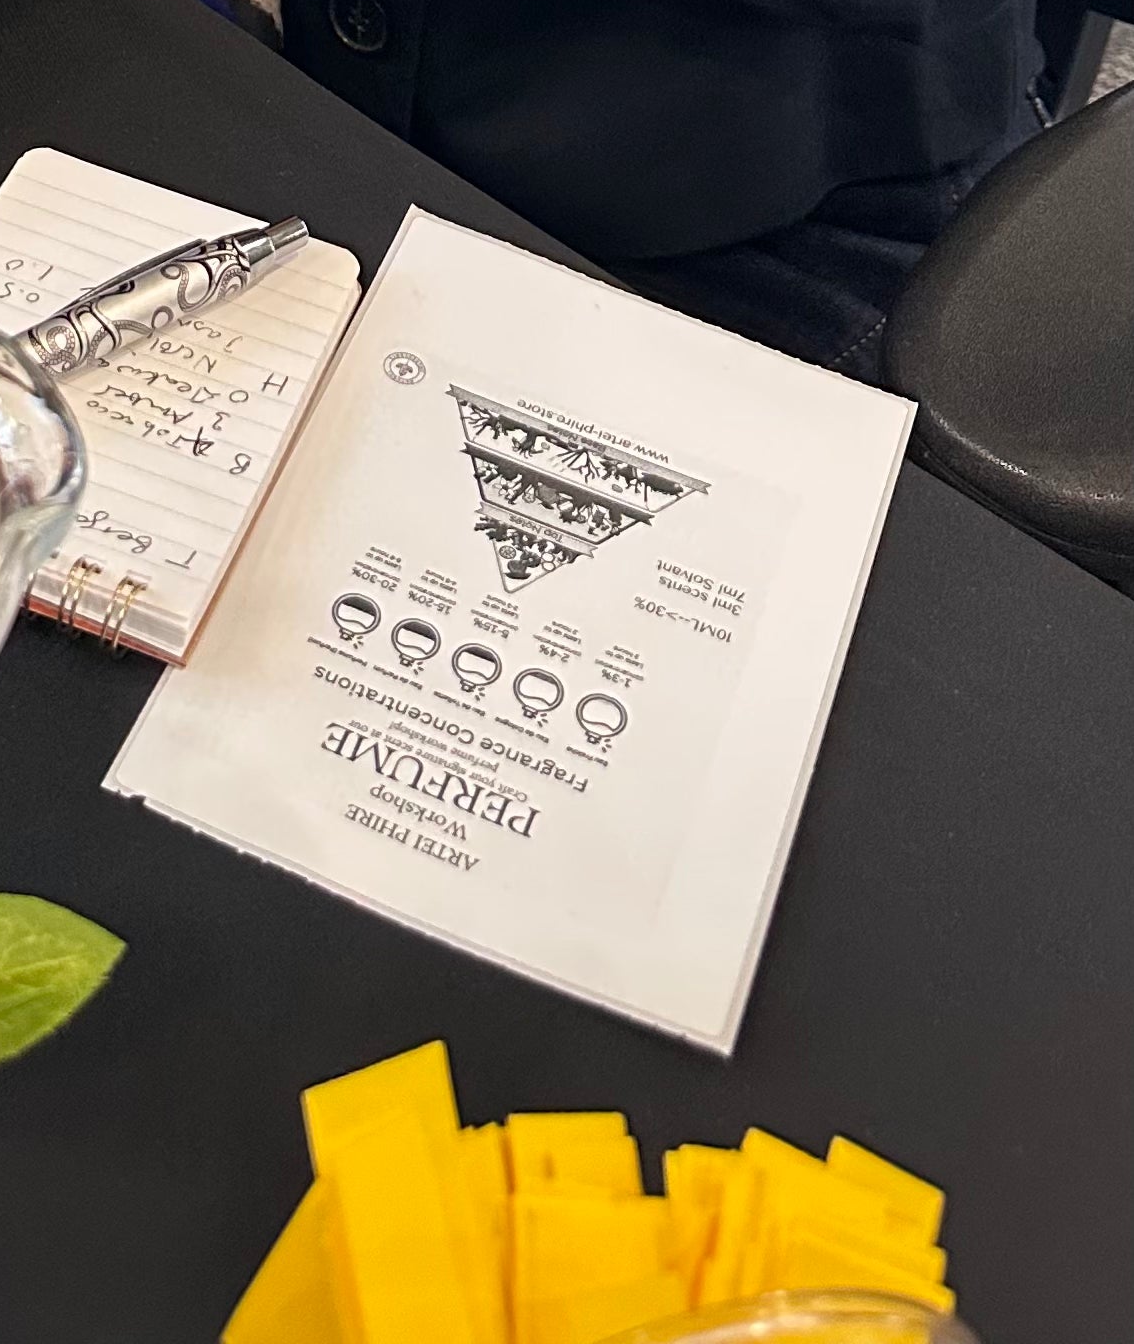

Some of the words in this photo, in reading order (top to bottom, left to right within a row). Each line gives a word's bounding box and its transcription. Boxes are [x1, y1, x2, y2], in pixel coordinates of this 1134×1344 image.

[262, 373, 288, 395] H
[658, 560, 714, 590] Solvant
[659, 576, 712, 601] scents
[713, 597, 744, 616] 3ml
[718, 584, 744, 603] 7ml
[314, 666, 474, 744] Concentrations
[383, 735, 413, 752] scent
[388, 722, 447, 751] workshop!
[415, 749, 466, 774] signature
[451, 748, 499, 773] perfume
[480, 738, 588, 792] Fragrance
[321, 723, 540, 838] PERFUME
[345, 804, 410, 844] PHIRE
[370, 784, 466, 841] Workshop
[413, 835, 479, 871] ARTEI
